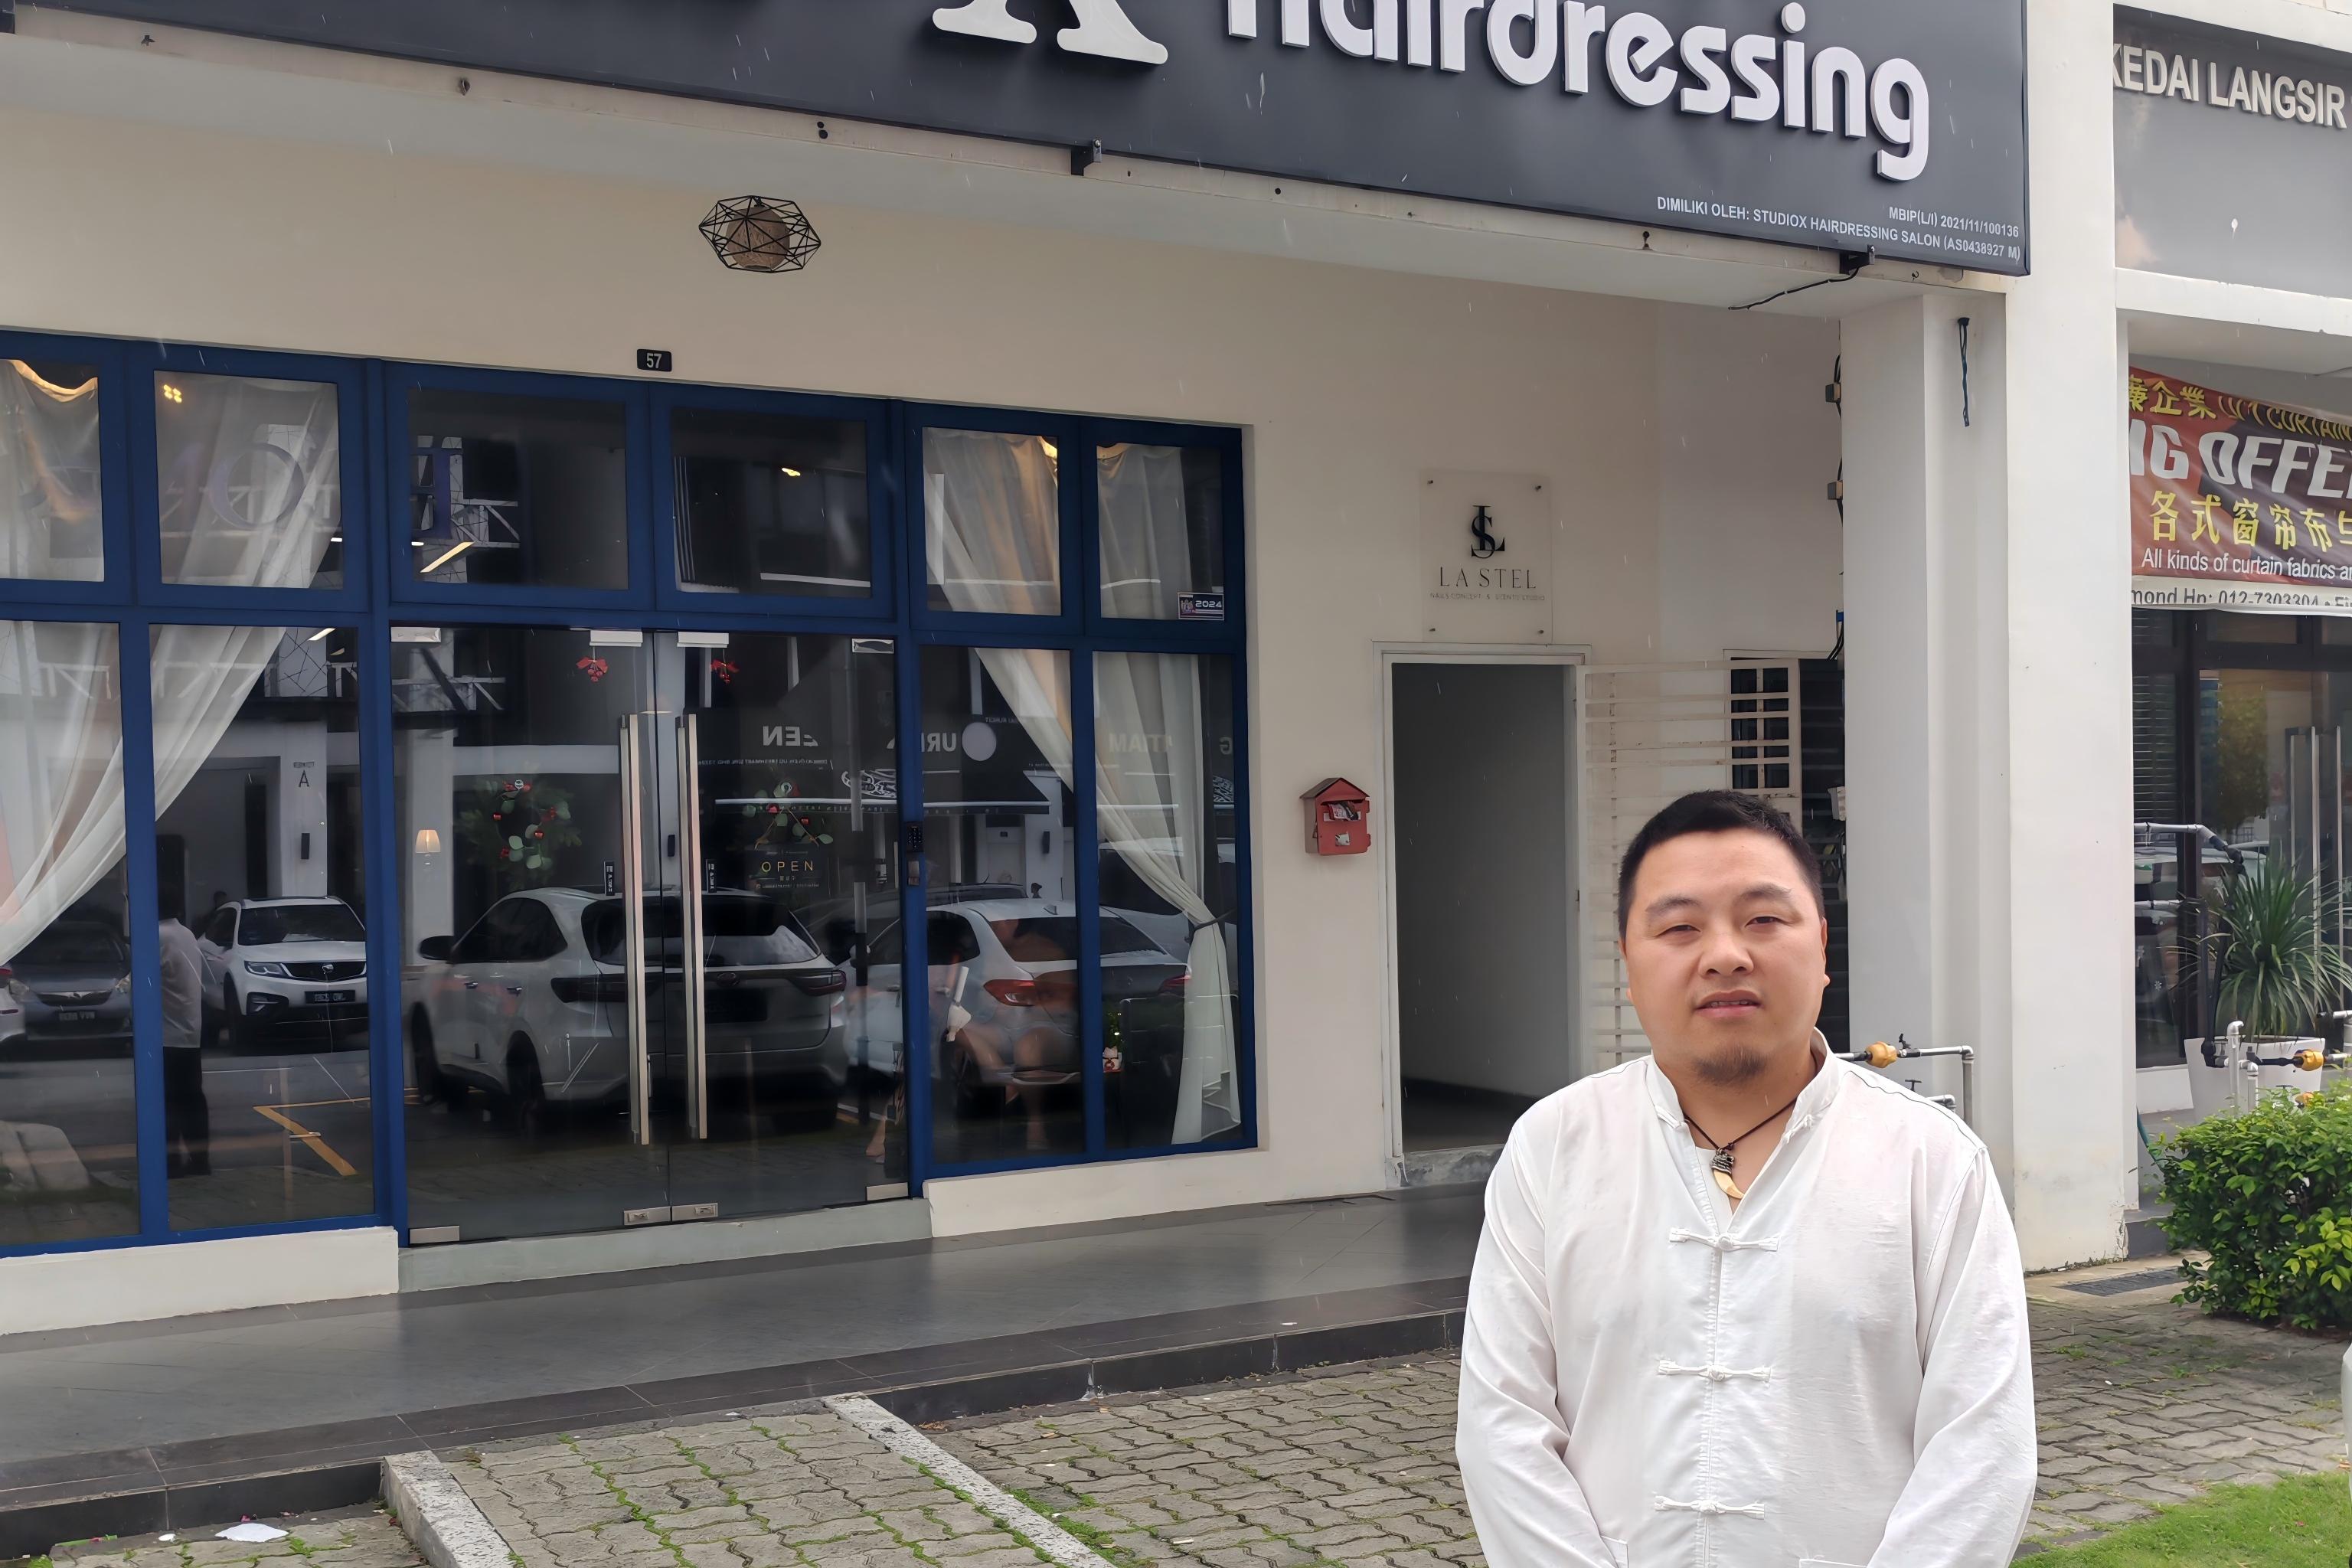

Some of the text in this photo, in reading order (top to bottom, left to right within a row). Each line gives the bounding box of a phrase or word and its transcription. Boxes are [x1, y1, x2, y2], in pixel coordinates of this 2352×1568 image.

[2207, 61, 2347, 129] LANGSIR
[1657, 196, 2020, 262] DIMILIKI OLEH: STUDIOX HAIRDRESSING SALON (AS0438927 M)
[1940, 214, 2019, 237] 2021/11/100136
[647, 353, 662, 368] 57
[2198, 431, 2352, 500] OFFE
[2141, 547, 2161, 568] All
[2167, 550, 2208, 571] kinds
[2213, 553, 2230, 573] of
[2233, 556, 2282, 576] curtain
[2286, 557, 2335, 580] fabrics
[1439, 567, 1537, 589] LA STEL
[761, 861, 814, 873] OPEN
